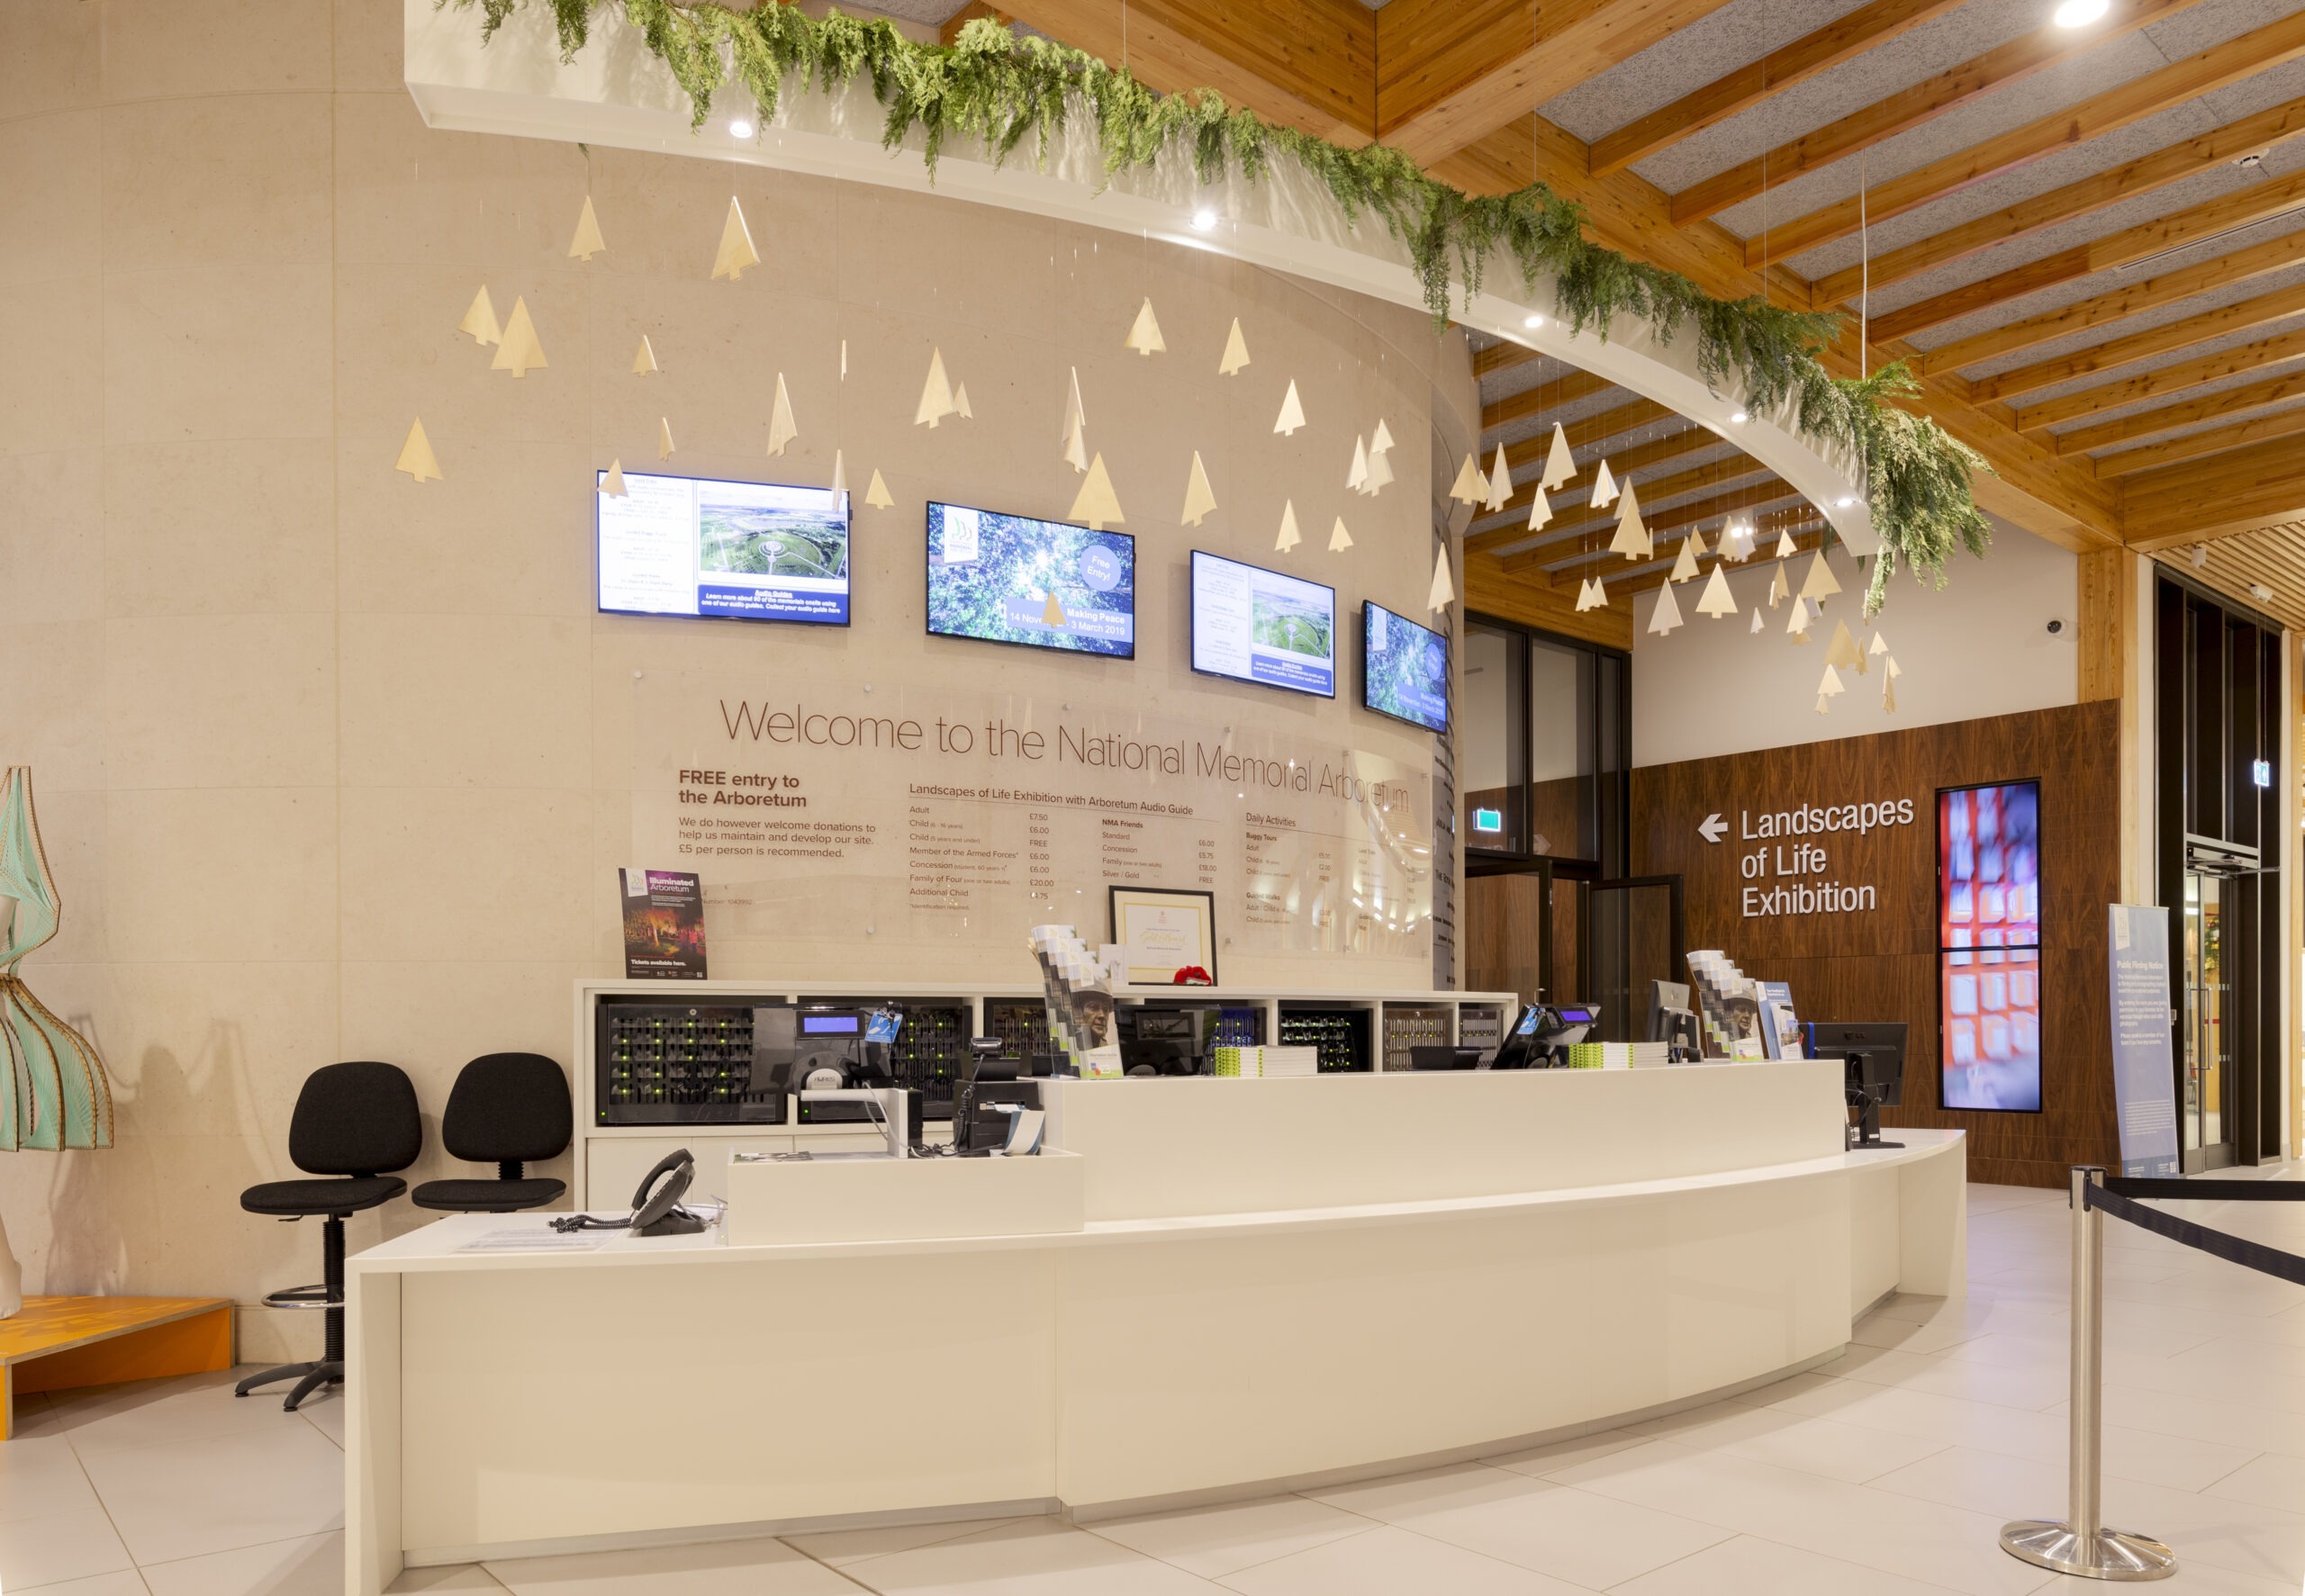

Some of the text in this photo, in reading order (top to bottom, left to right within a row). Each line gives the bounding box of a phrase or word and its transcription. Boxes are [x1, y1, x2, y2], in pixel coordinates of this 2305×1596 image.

[1091, 555, 1110, 569] Free
[1087, 566, 1111, 582] Entry!
[1010, 612, 1020, 621] 14
[1071, 621, 1077, 629] 3
[1079, 622, 1103, 634] March
[1105, 625, 1125, 636] 2019
[1067, 609, 1125, 624] Making Peace
[720, 699, 1409, 813] Welcome to the National Memorial Arboretum
[679, 770, 800, 790] FREE entry to
[679, 789, 807, 807] the Arboretum
[909, 783, 1193, 816] Landscapes of Life Exhibition with Arboretum Audio Guide
[909, 806, 1048, 821] Adult £7.50
[1246, 812, 1297, 827] Daily Activities
[1741, 798, 1914, 840] Landscapes
[679, 817, 876, 833] We do however welcome donations to
[1102, 818, 1143, 828] NMA Friends
[679, 830, 702, 842] help
[720, 831, 765, 842] maintain
[768, 833, 788, 842] and
[791, 833, 832, 844] develop
[834, 835, 851, 843] our
[854, 834, 873, 844] site.
[1102, 832, 1214, 847] Standard £6.00
[1246, 833, 1262, 841] Buggy
[679, 844, 845, 858] £5 per person is recommended.
[909, 847, 941, 855] Member
[1102, 844, 1137, 853] Concession
[909, 861, 953, 869] Concession
[1102, 858, 1122, 867] Family
[1198, 864, 1216, 872] £18.00
[1741, 843, 1827, 879] of Life
[649, 877, 694, 887] Illuminated
[909, 875, 934, 883] Family
[1029, 879, 1053, 888] £20.00
[1102, 870, 1119, 879] Silver
[1125, 871, 1139, 879] Gold
[650, 884, 690, 893] Arboretum
[1742, 882, 1876, 917] Exhibition
